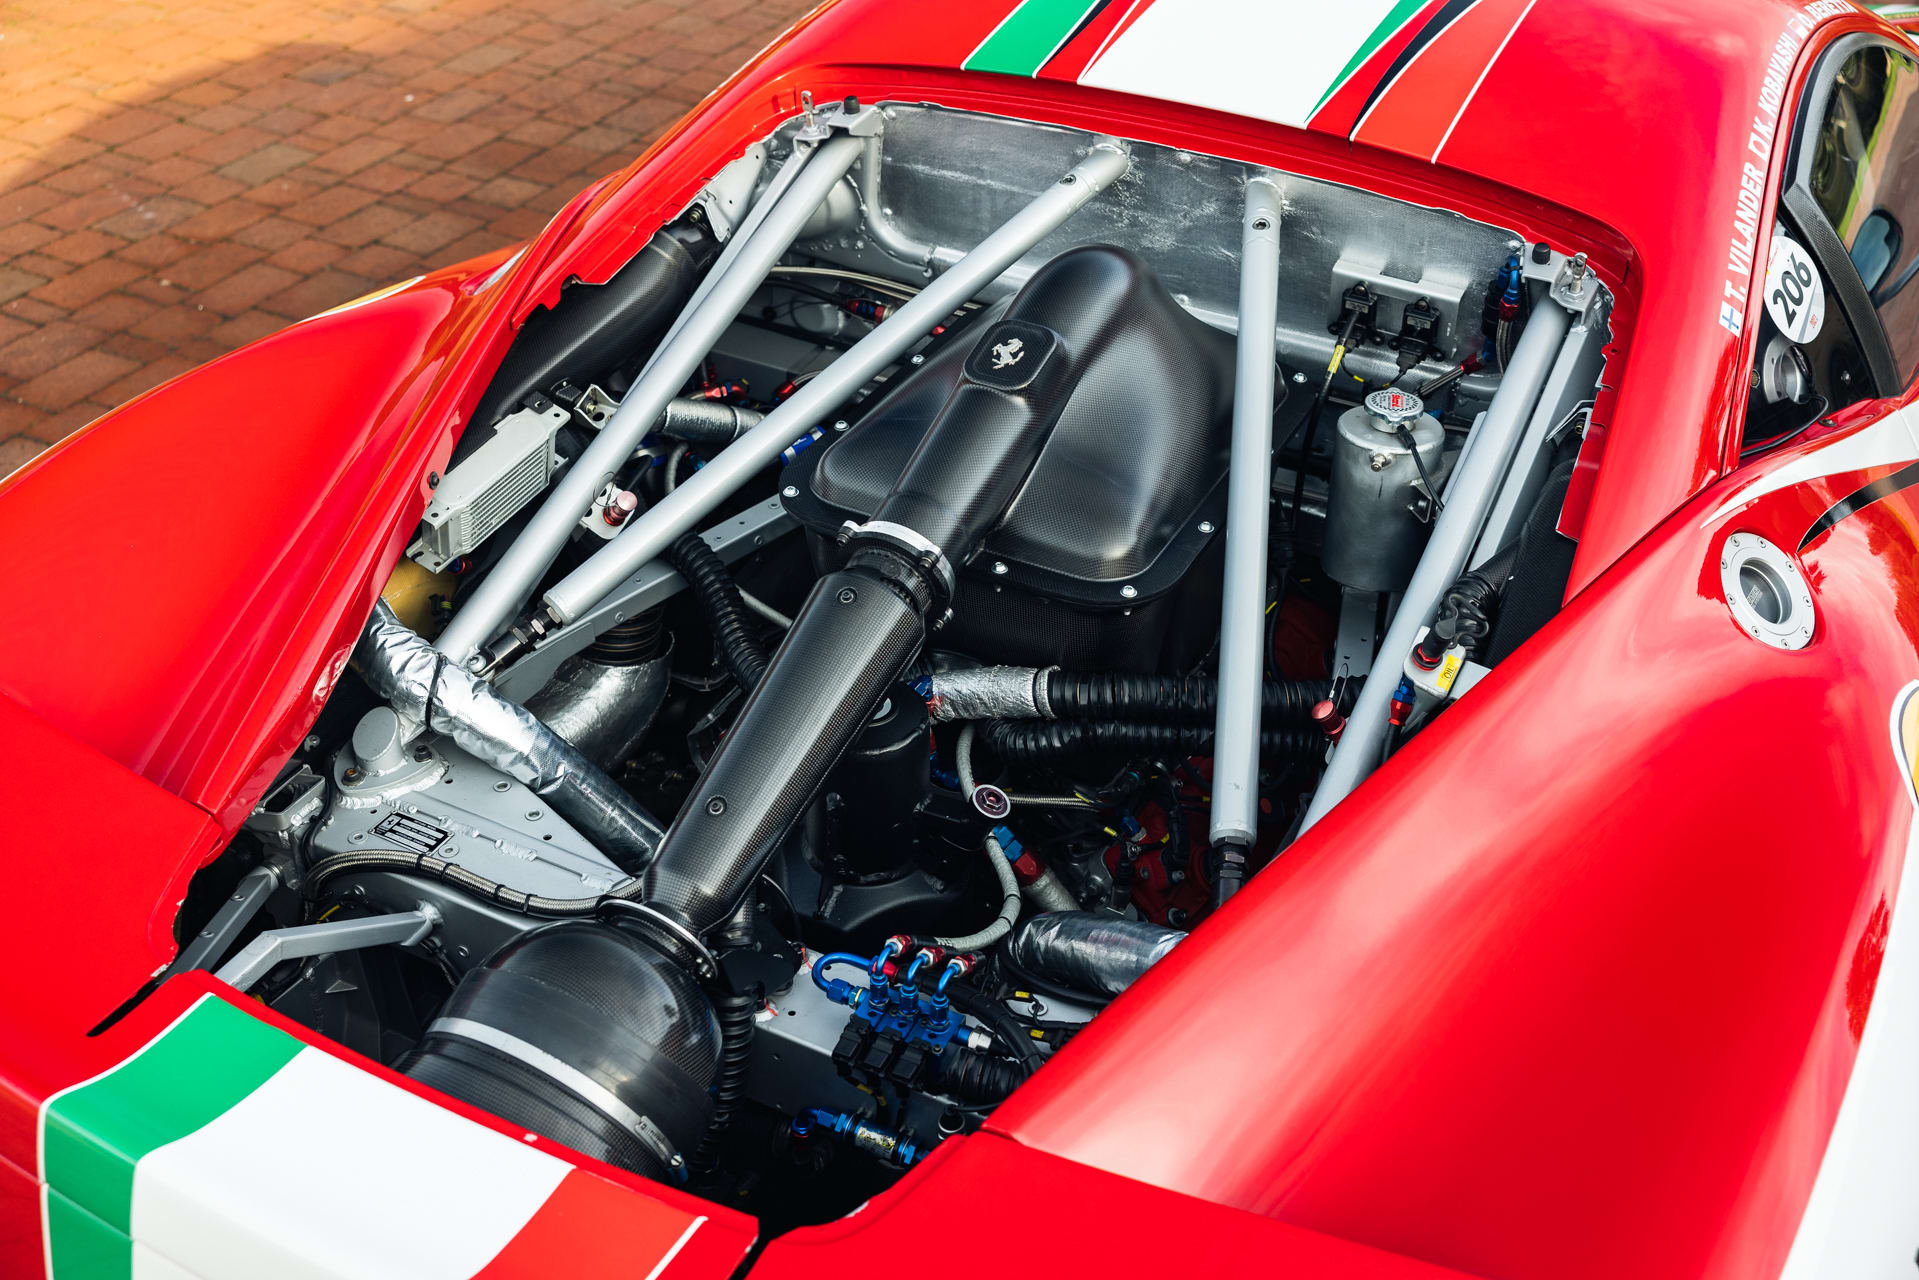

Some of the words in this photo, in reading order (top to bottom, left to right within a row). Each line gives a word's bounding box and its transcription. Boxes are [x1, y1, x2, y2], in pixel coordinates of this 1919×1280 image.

[1758, 31, 1799, 118] KOBAYASHI
[1753, 115, 1774, 141] K.
[1728, 162, 1763, 276] VILANDER
[1724, 280, 1746, 303] T.
[1773, 252, 1812, 329] 206
